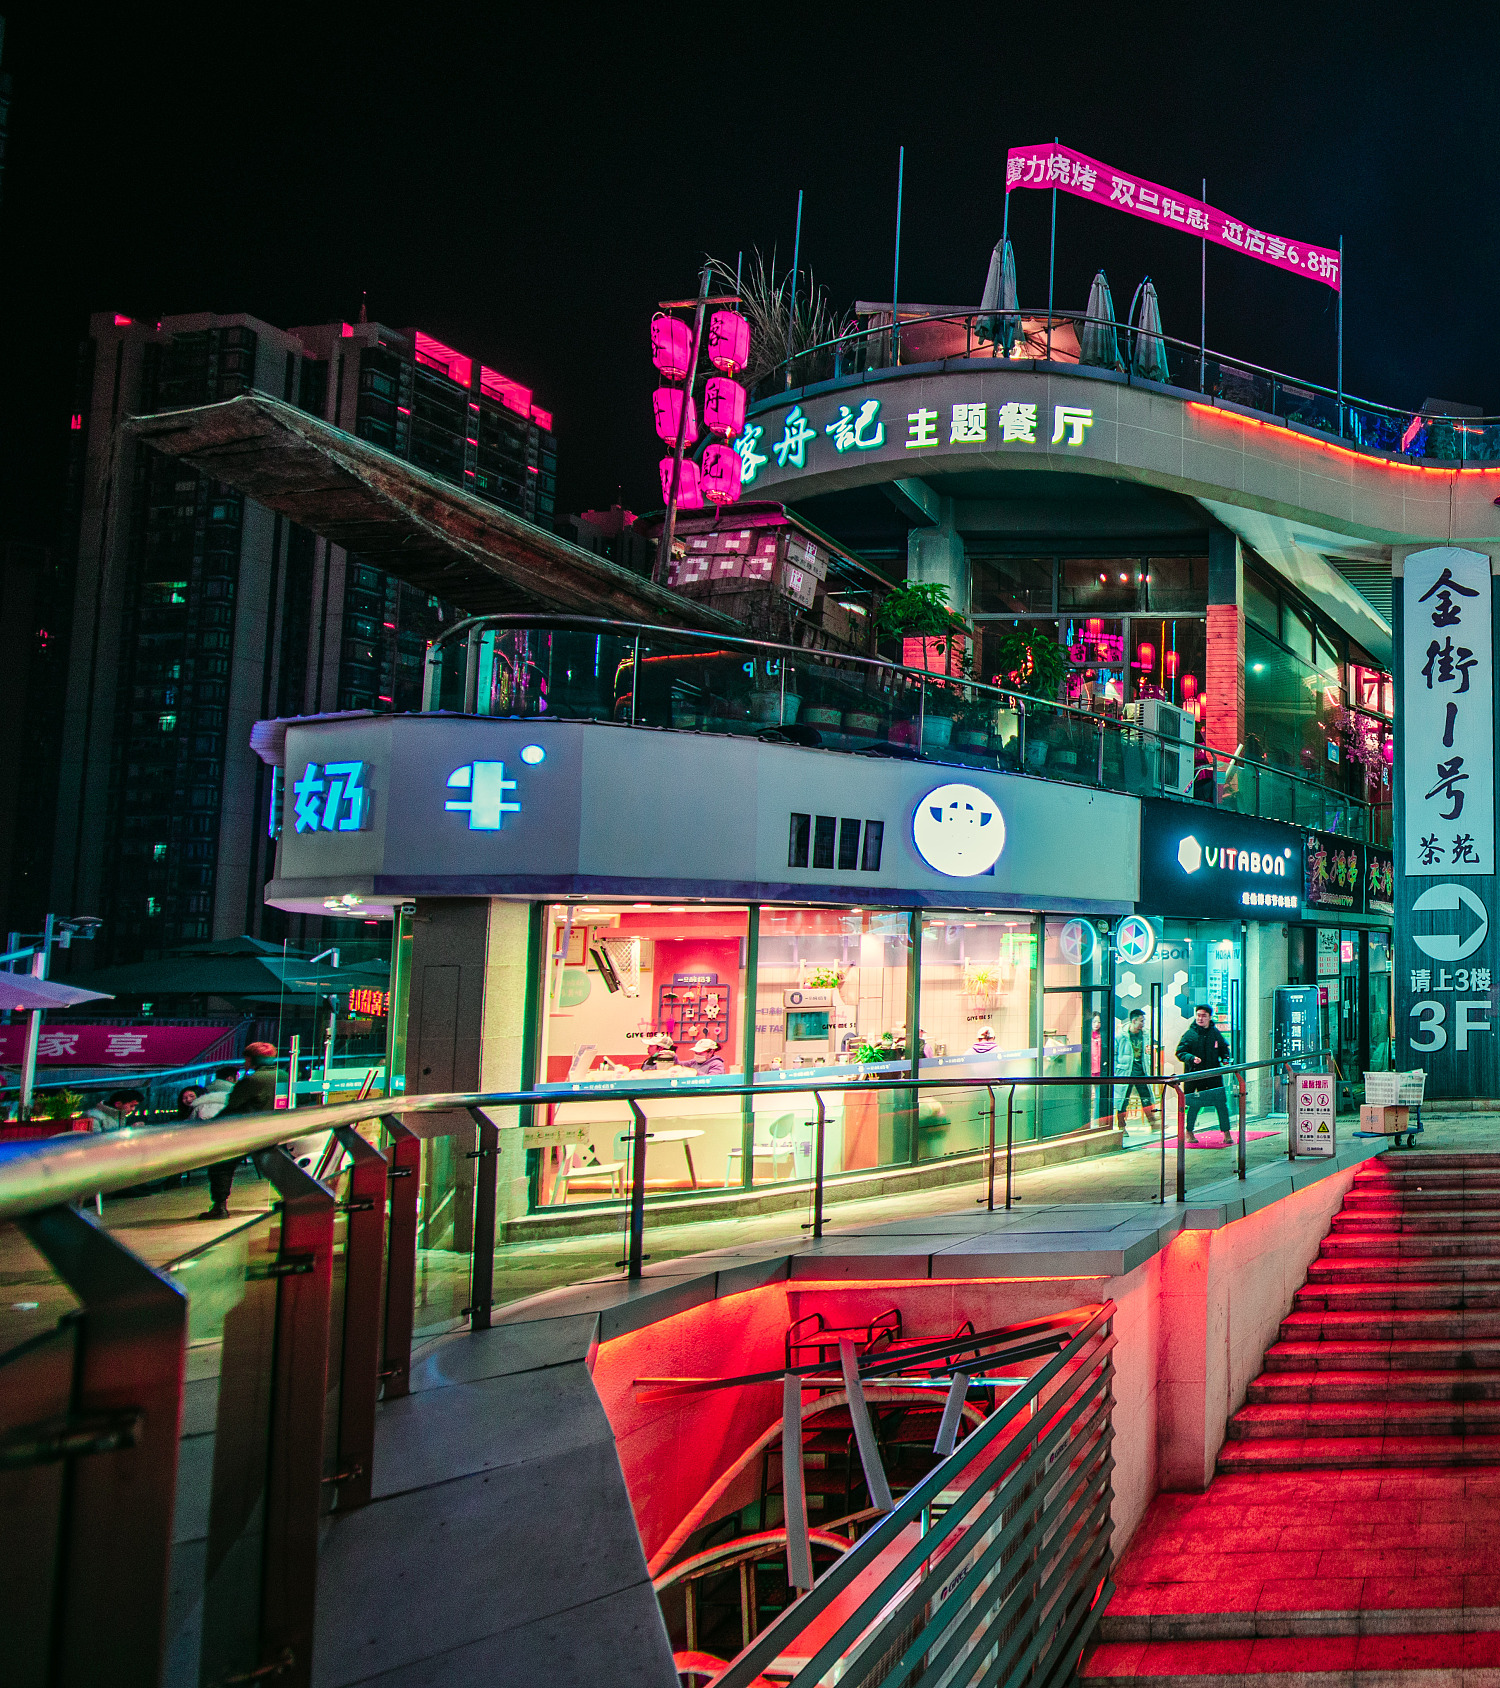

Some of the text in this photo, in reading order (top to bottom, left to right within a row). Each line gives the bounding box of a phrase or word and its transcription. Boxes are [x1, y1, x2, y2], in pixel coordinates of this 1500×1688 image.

[905, 401, 1094, 450] 主题餐厅
[1205, 846, 1286, 876] VITABON
[1417, 833, 1480, 865] 茶苑
[1411, 968, 1492, 993] 请上3楼
[1409, 1001, 1492, 1052] 3F
